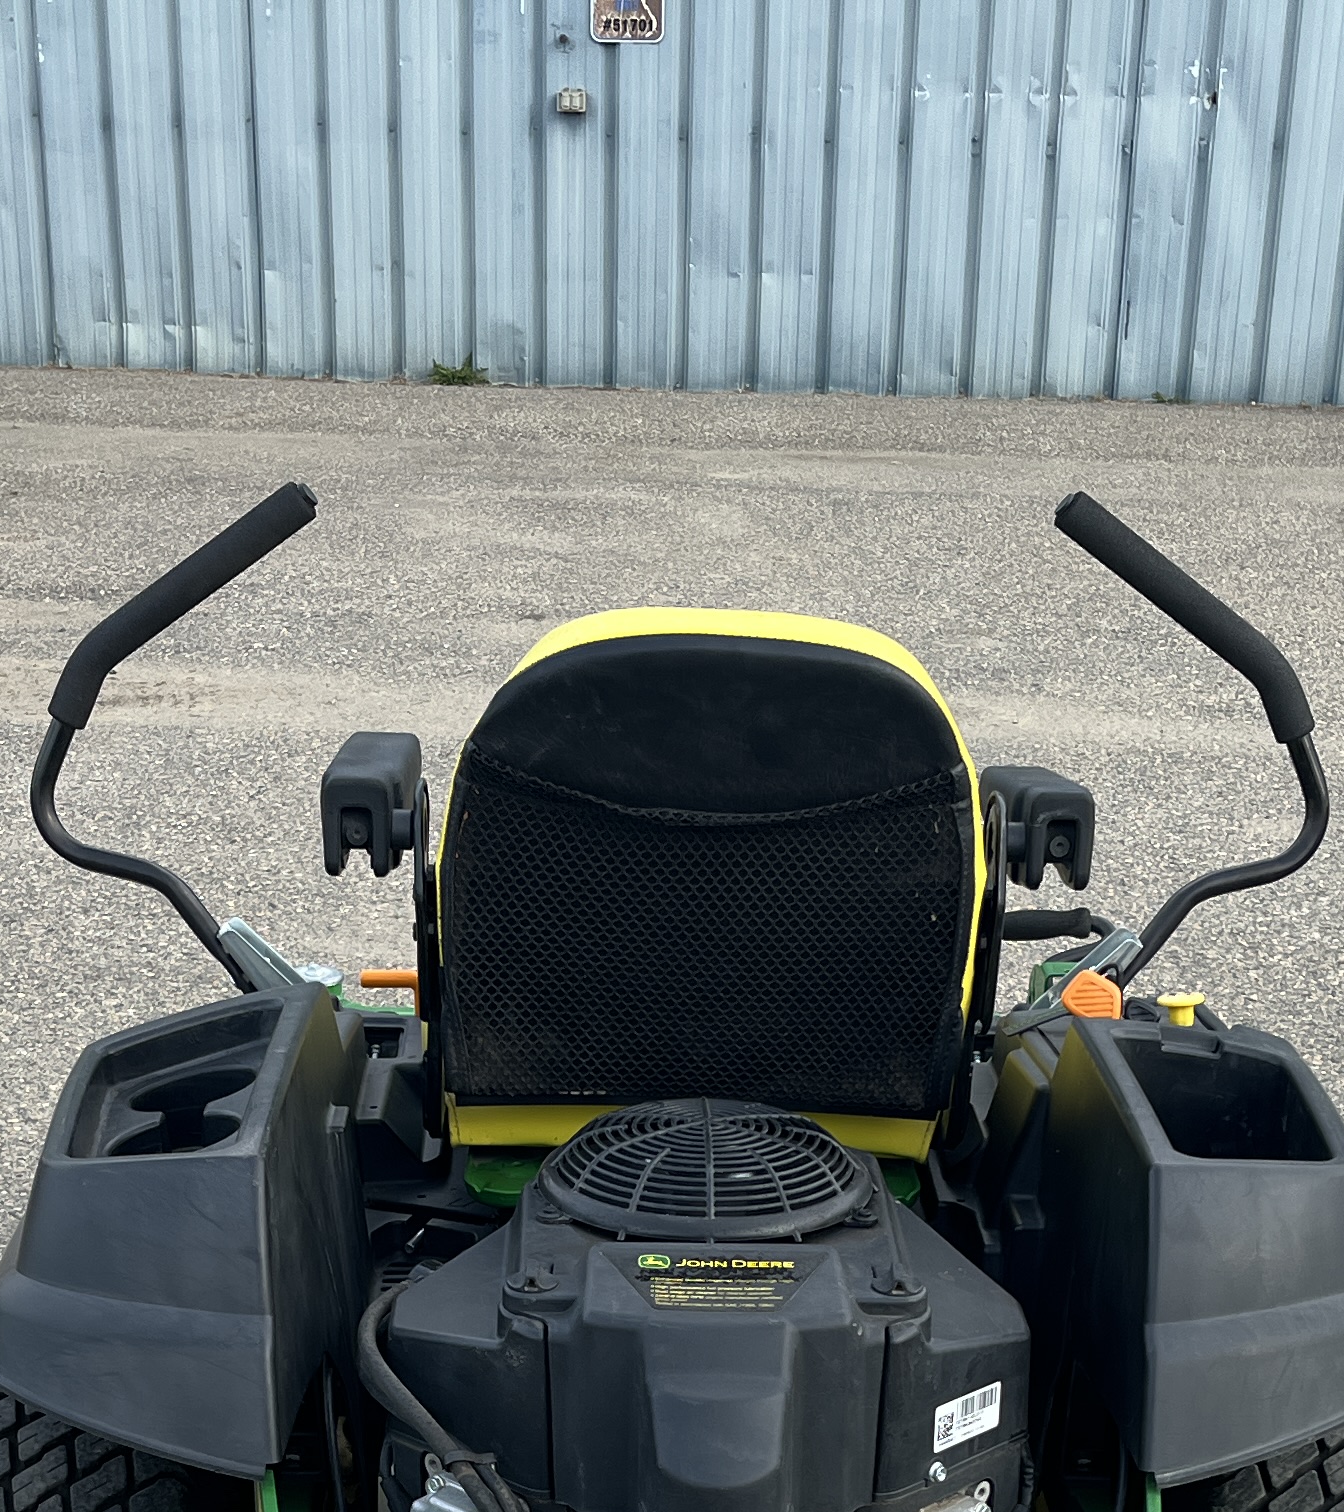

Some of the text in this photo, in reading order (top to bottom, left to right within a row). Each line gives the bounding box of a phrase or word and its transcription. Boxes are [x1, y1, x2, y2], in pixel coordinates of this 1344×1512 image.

[603, 18, 653, 32] #51701
[675, 1258, 795, 1269] JOHN DEERE
